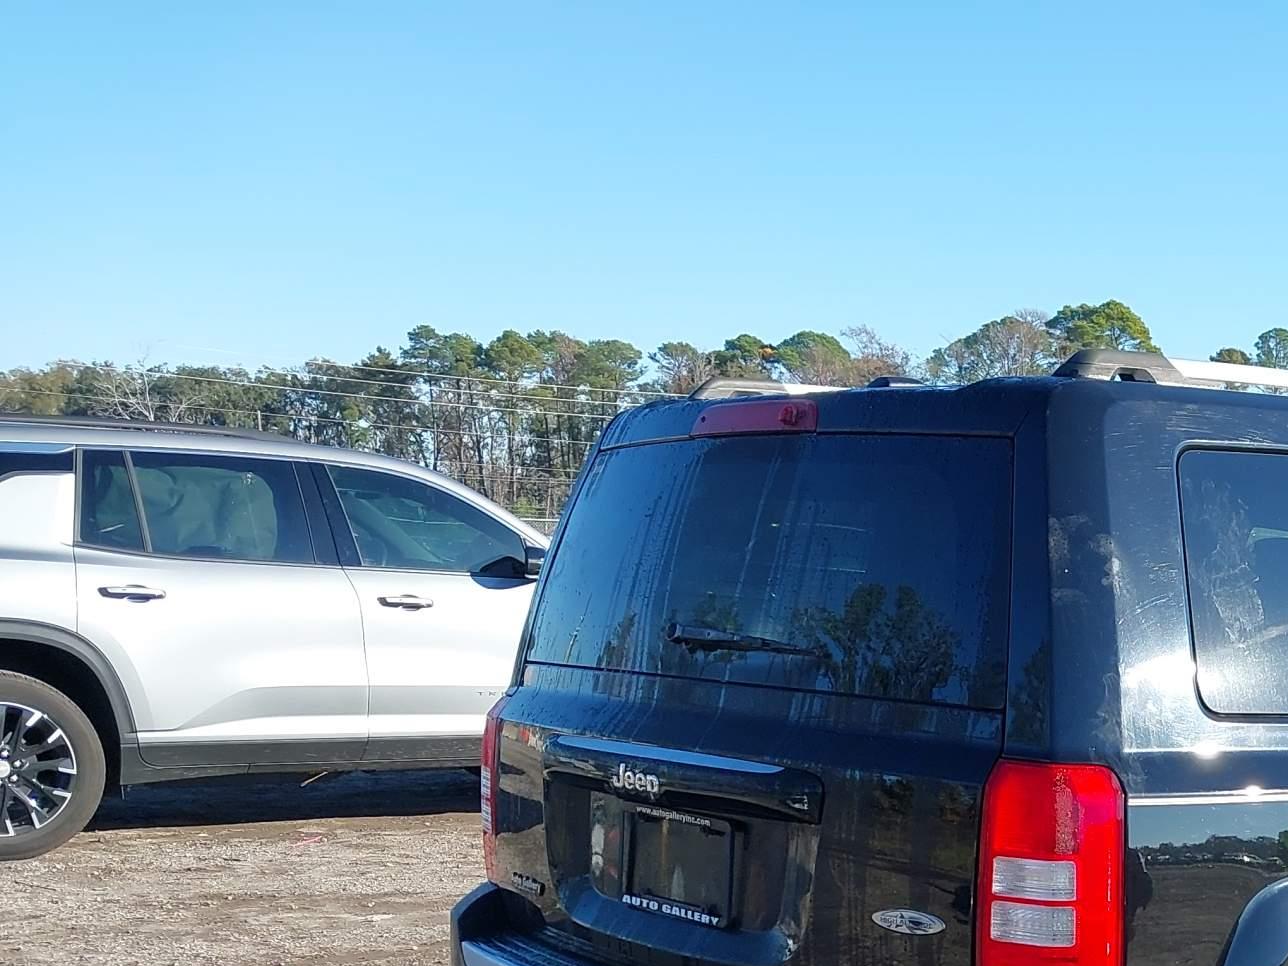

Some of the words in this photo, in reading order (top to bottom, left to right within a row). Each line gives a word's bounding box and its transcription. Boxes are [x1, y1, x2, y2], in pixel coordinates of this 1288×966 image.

[612, 763, 659, 796] Jeep
[622, 895, 659, 911] AUTO
[661, 904, 720, 926] GALLERY
